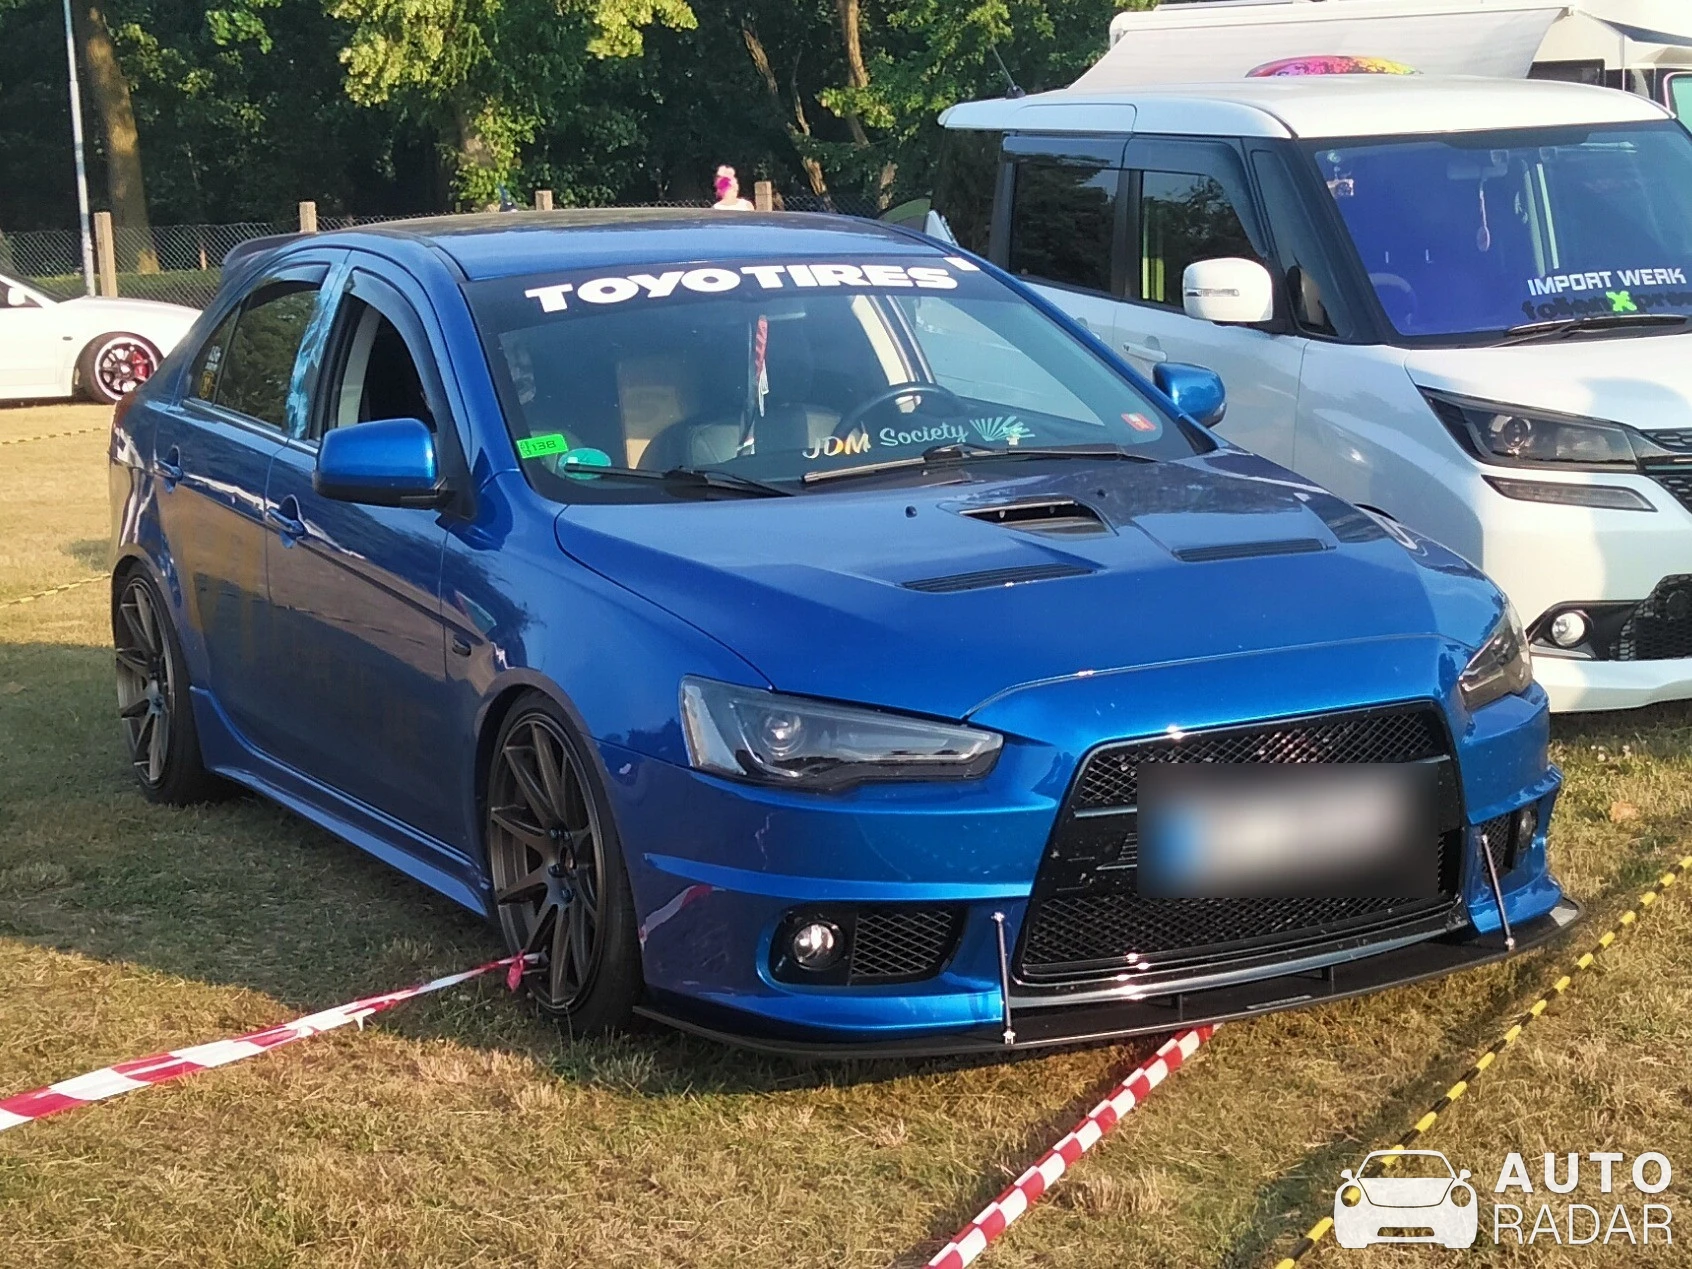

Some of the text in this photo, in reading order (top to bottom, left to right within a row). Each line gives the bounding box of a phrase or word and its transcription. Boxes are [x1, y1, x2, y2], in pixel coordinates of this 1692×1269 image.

[1527, 267, 1687, 296] IMPORT WERK
[802, 422, 969, 459] JDM Society
